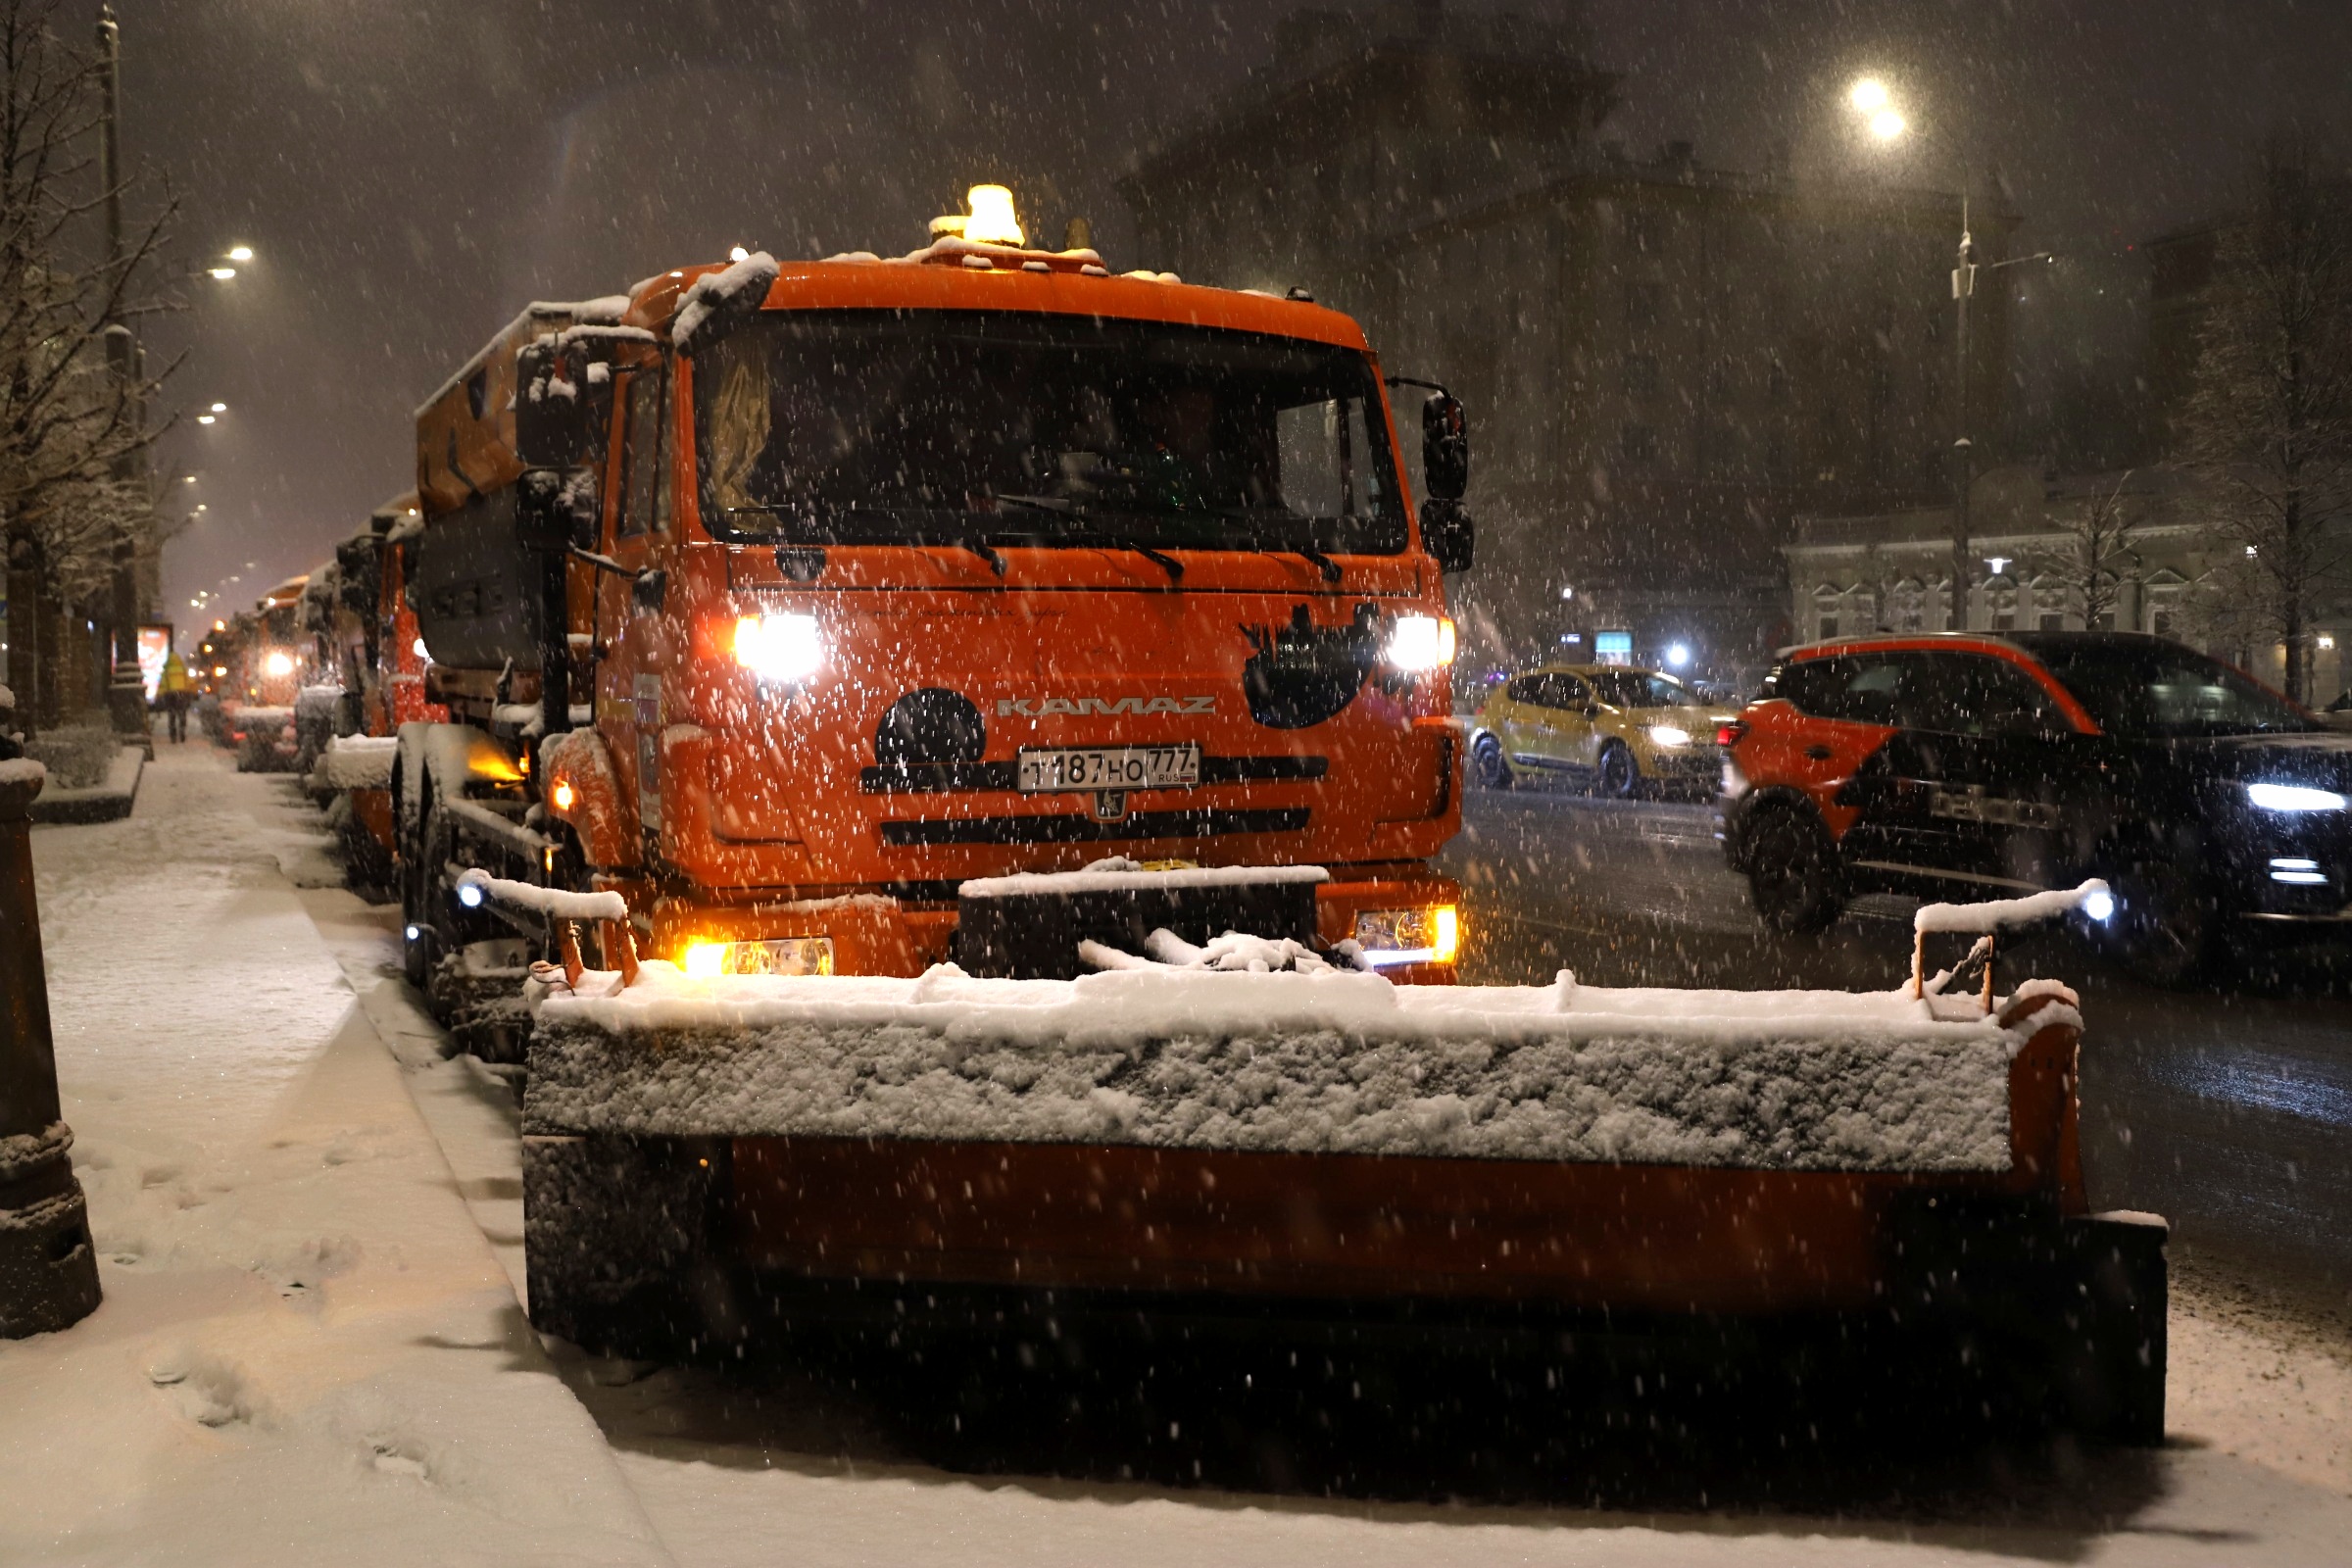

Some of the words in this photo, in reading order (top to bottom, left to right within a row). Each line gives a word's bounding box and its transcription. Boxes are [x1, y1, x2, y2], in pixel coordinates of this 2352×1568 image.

[997, 697, 1216, 716] KAMAZ
[1149, 750, 1192, 773] 777
[1158, 773, 1180, 783] RUS
